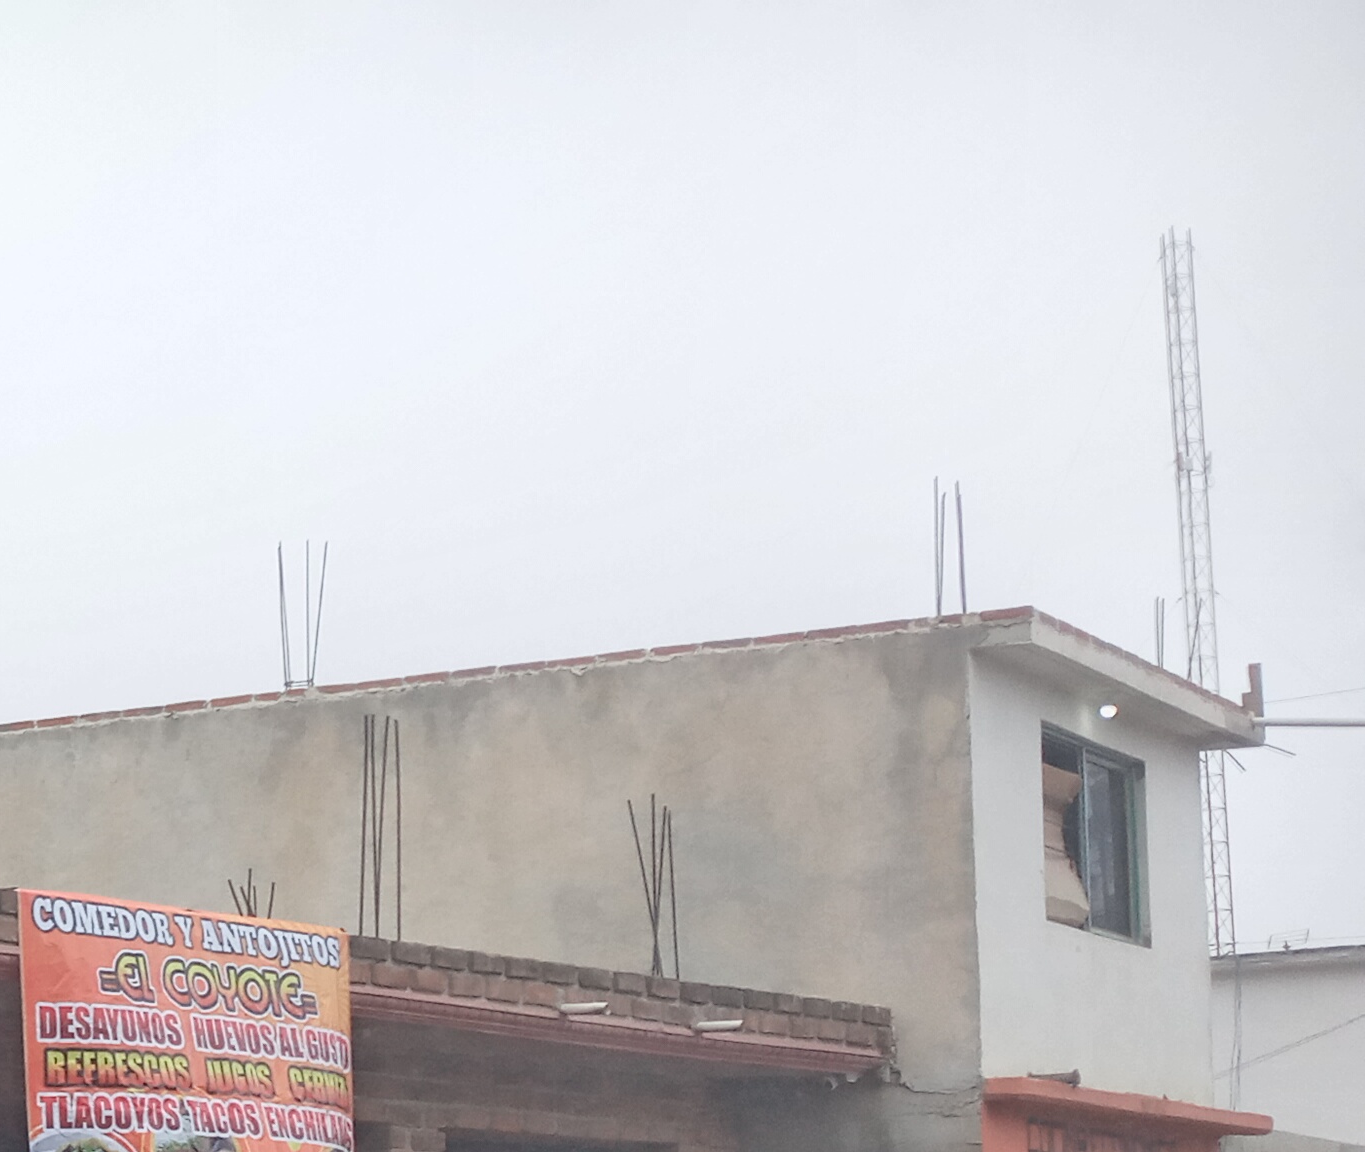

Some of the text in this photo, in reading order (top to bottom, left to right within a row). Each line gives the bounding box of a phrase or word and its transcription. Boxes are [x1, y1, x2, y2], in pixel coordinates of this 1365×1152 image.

[32, 896, 340, 969] COMEDOR Y ANTOJITOS
[115, 951, 307, 1019] EL COYOTE
[38, 1005, 183, 1047] DESAYUNOS
[192, 1015, 276, 1058] HUEVOS
[277, 1025, 304, 1060] AL
[45, 1048, 193, 1091] REFRESCOS
[206, 1057, 276, 1100] JUGOS
[39, 1094, 181, 1131] TLACOYOS
[186, 1098, 262, 1138] TACOS
